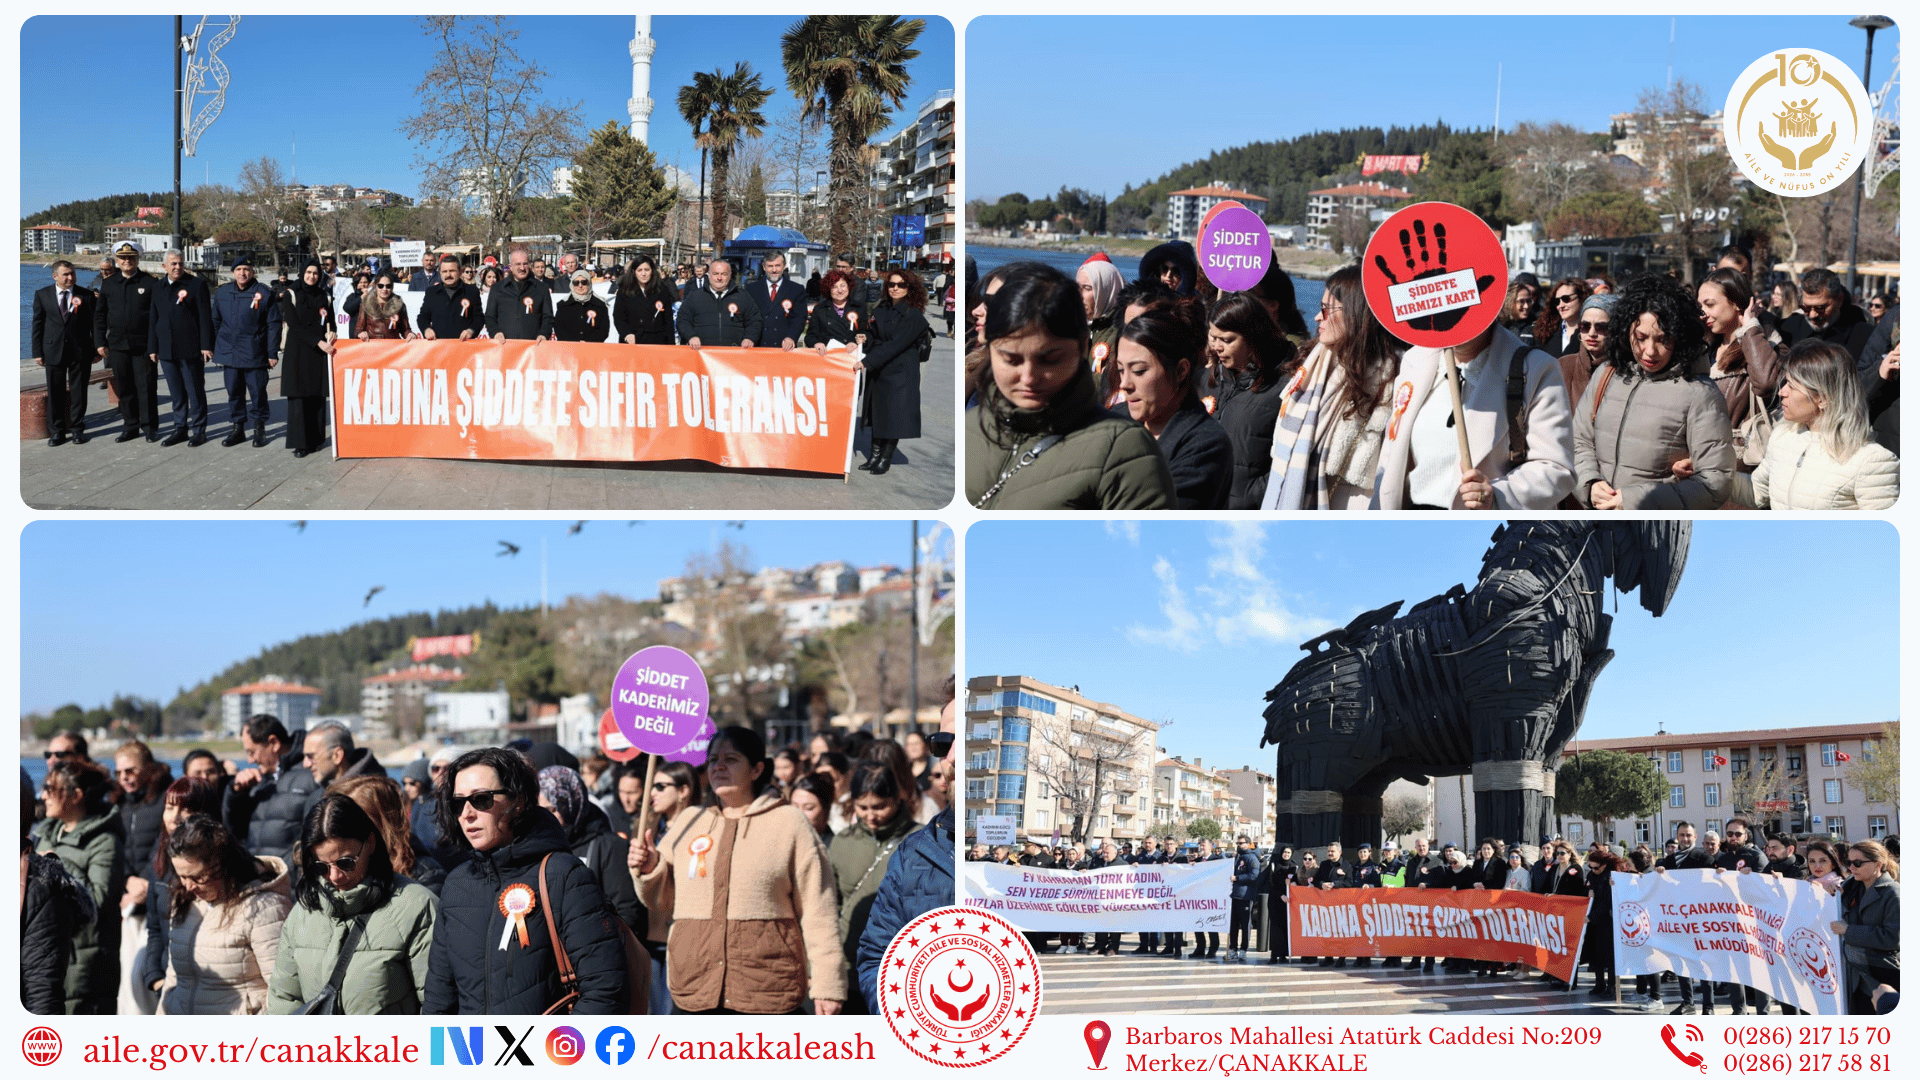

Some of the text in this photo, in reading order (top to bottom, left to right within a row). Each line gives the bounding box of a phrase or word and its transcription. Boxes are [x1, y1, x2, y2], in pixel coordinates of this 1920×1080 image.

[1213, 228, 1260, 248] ŞİDDET
[1208, 254, 1262, 271] SUÇTUR
[1408, 278, 1458, 300] ŞİDDETE
[1396, 289, 1476, 316] KIRMIZI KART
[344, 354, 828, 438] KADINA ŞİDDETE SIFIR TOLERANS!
[636, 666, 689, 689] ŞİDDET
[619, 689, 700, 716] KADERİMİZ
[634, 715, 676, 736] DEĞİL
[1023, 872, 1165, 885] EY KAHRAMAN TÜRK KADINI,
[1006, 886, 1027, 897] SEN
[1029, 888, 1061, 899] YERDE
[1062, 888, 1144, 900] SÜRÜKLENMEYE
[1055, 902, 1101, 913] GÖKLERE
[1660, 904, 1678, 916] T.C.
[1680, 902, 1754, 919] ÇANAKKALE
[1300, 898, 1567, 956] KADINA ŞİDDETE SIFIR TOLERANS!
[1657, 920, 1681, 933] AİLE
[1682, 922, 1700, 933] VE
[1702, 921, 1751, 935] SOSYAL
[1694, 938, 1708, 951] İL
